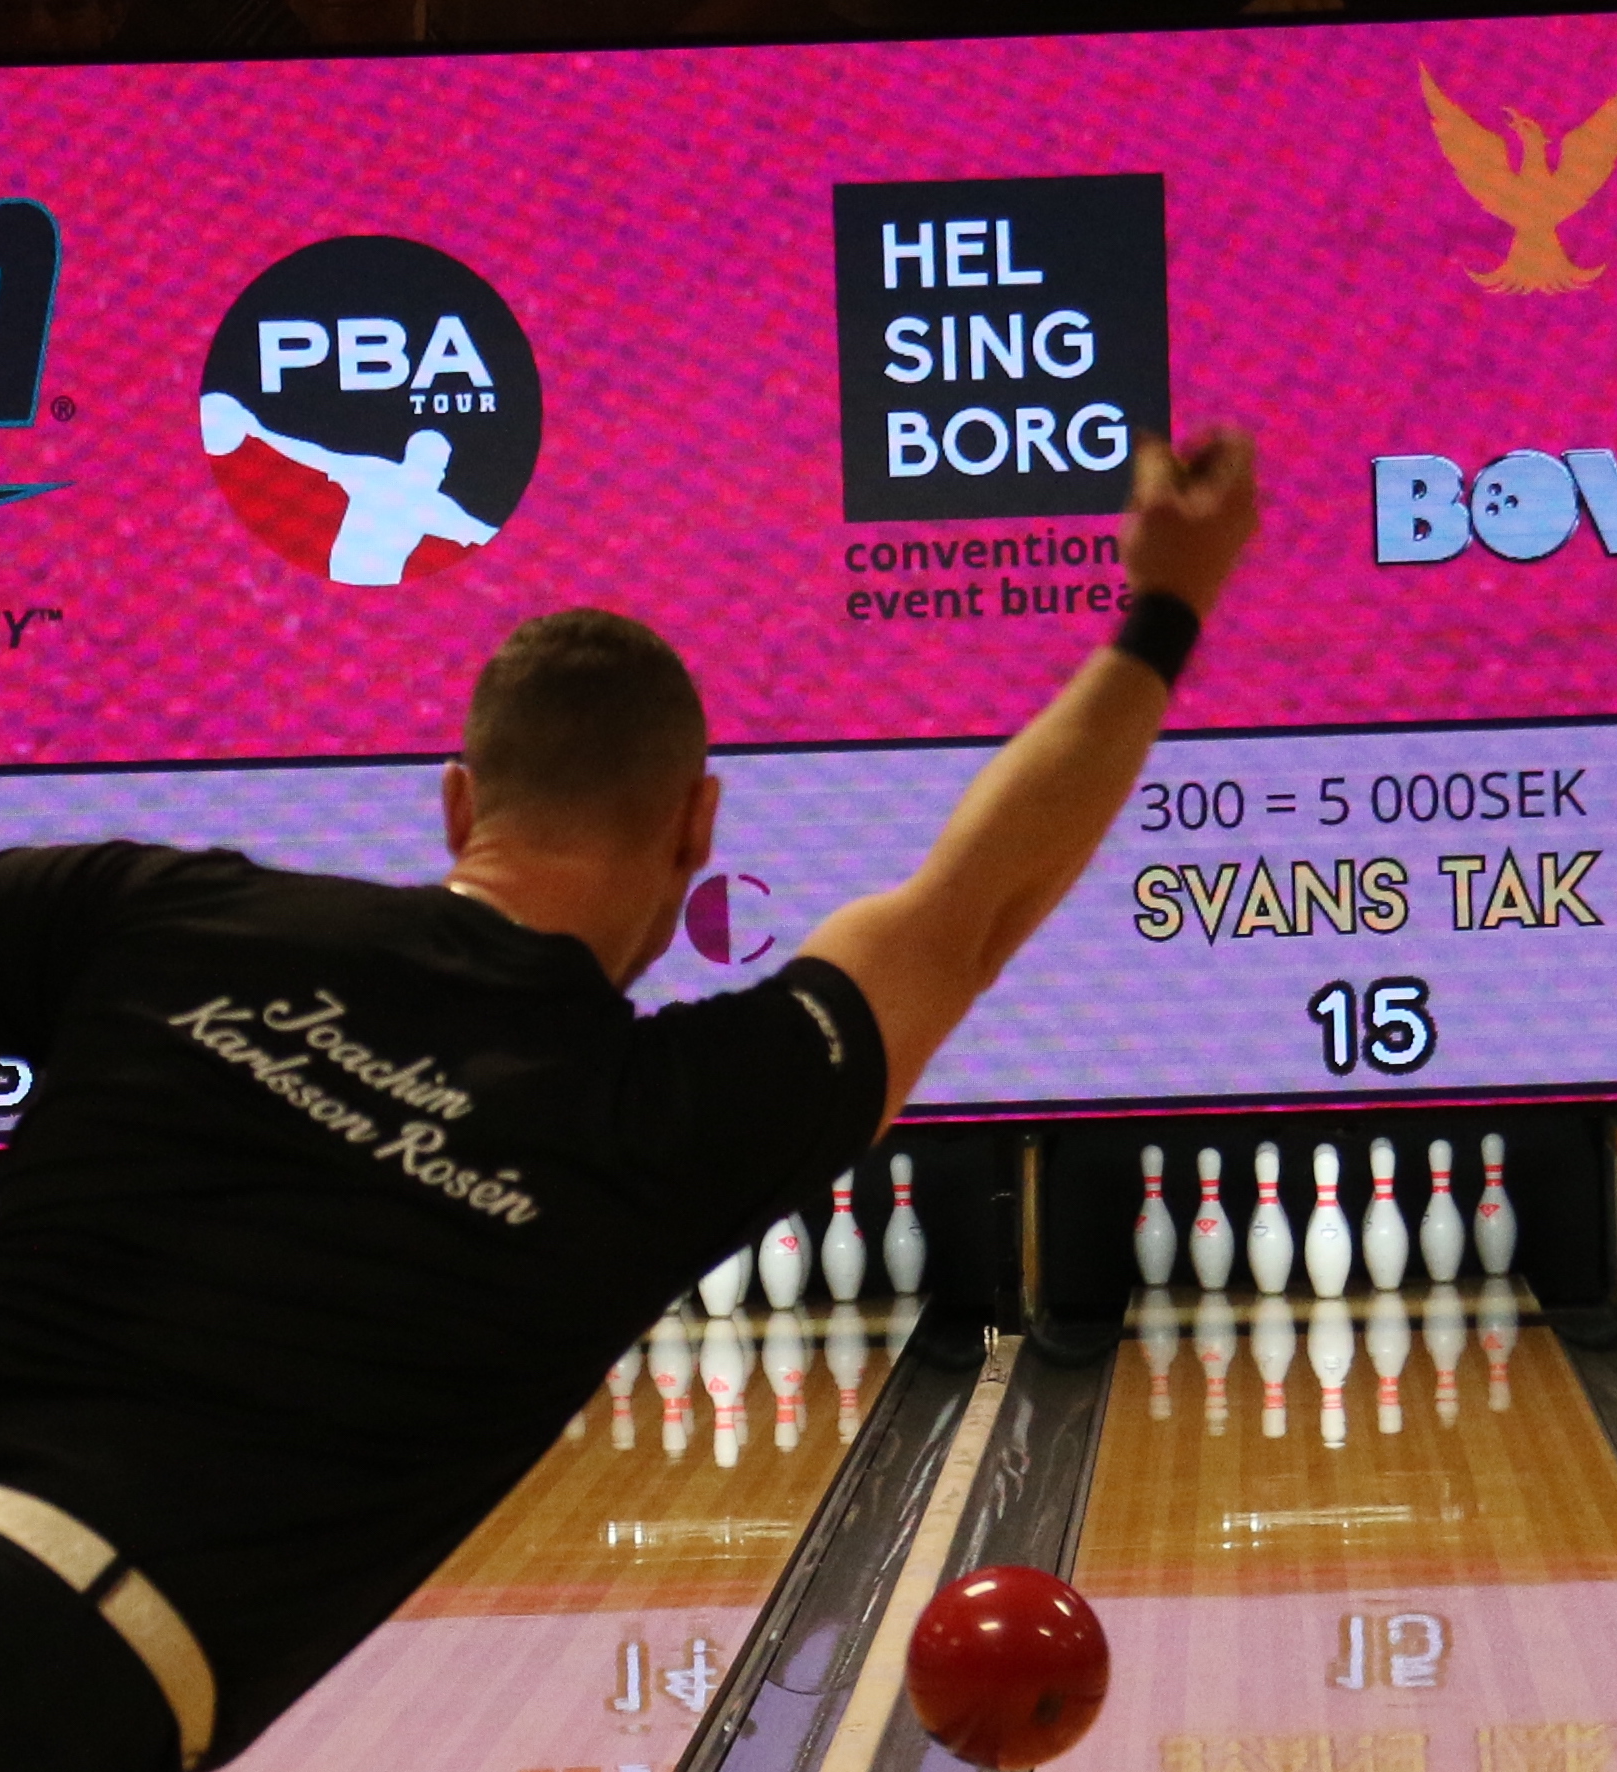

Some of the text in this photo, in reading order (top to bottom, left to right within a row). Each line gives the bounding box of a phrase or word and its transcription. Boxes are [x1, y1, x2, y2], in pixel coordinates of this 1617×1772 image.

[882, 219, 1043, 290] HEL
[258, 315, 494, 393] PBA
[883, 309, 1095, 384] SING
[410, 393, 497, 415] TOUR
[886, 402, 1131, 478] BORG
[844, 528, 1120, 572] convention
[846, 584, 984, 620] event
[1139, 781, 1245, 831] 300
[1318, 778, 1349, 826] 5
[1370, 769, 1587, 822] 000SEK
[1134, 847, 1603, 946] SVANS TAK
[262, 988, 475, 1120] Joachim
[1308, 977, 1437, 1075] 15
[167, 994, 541, 1226] Karlsson Rosén
